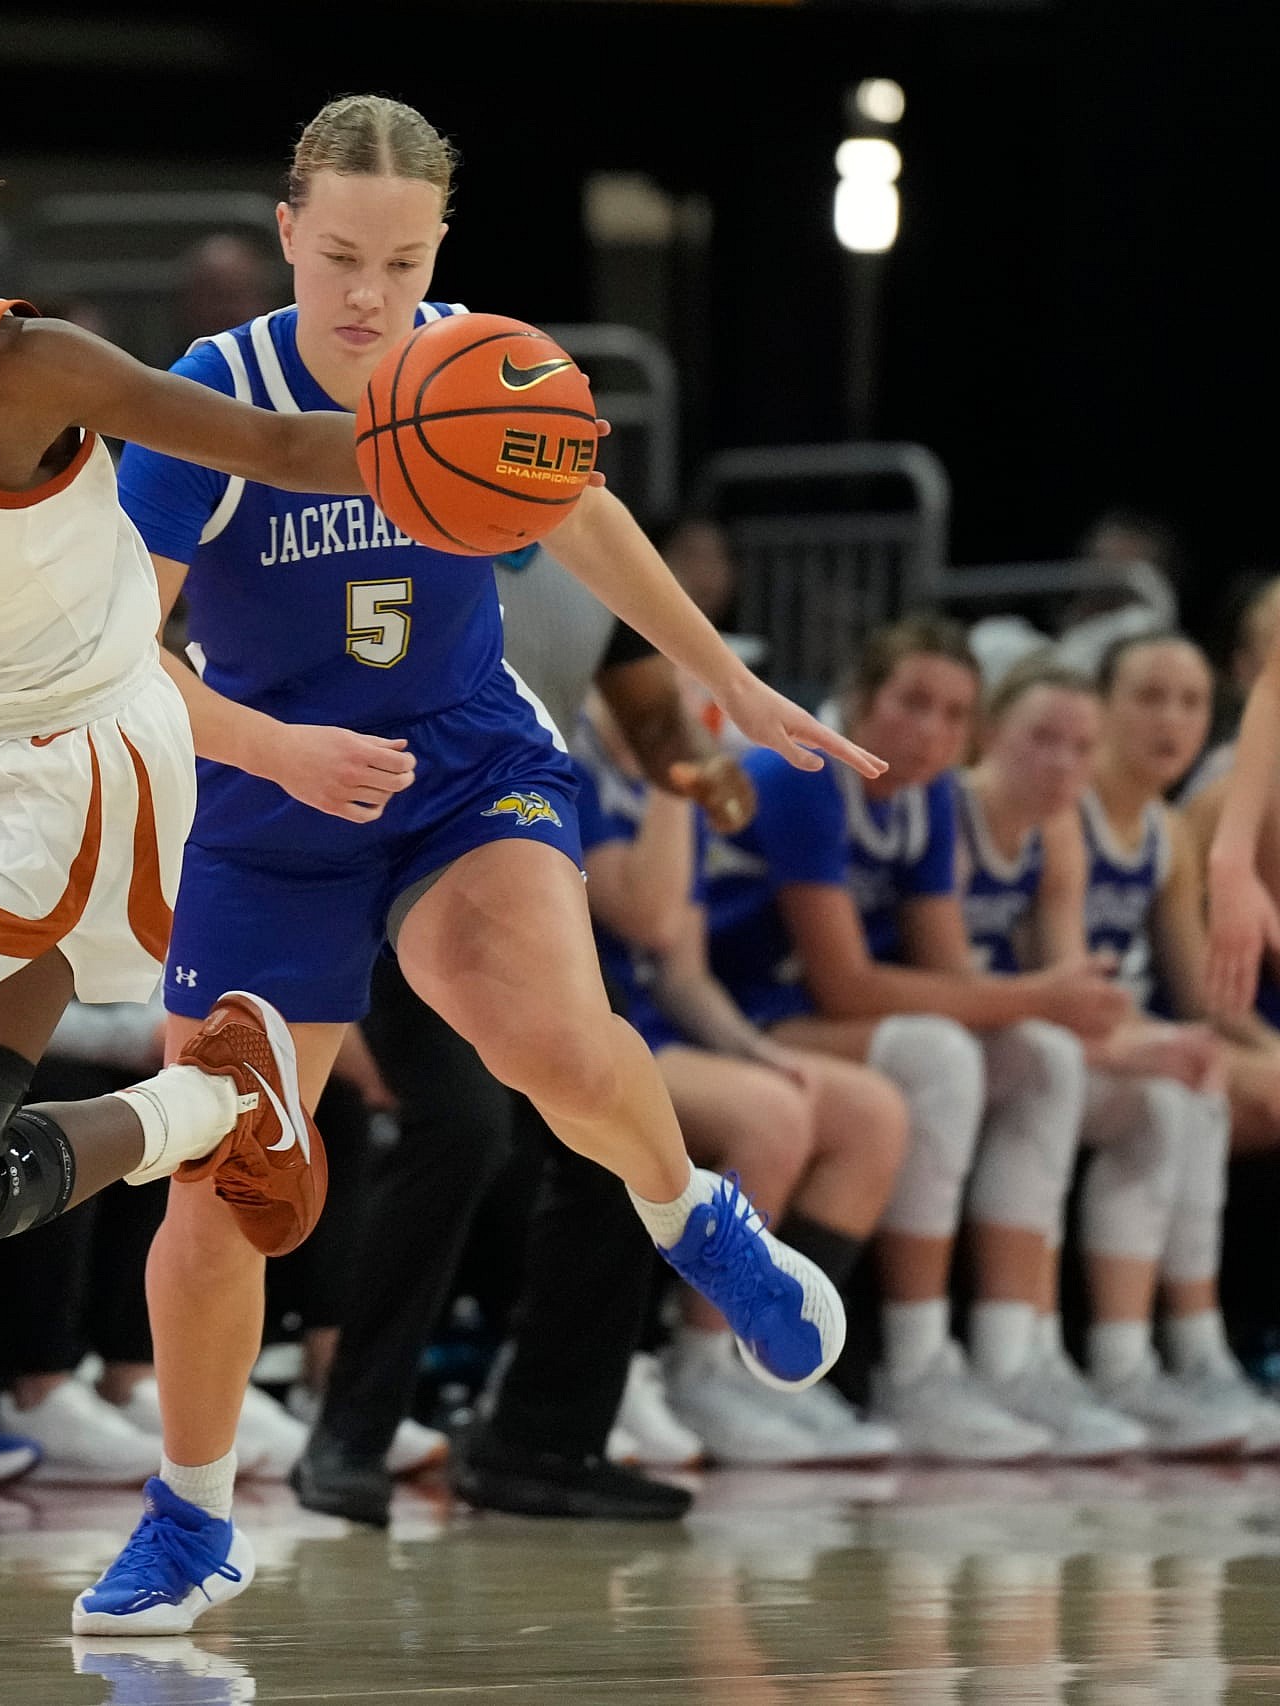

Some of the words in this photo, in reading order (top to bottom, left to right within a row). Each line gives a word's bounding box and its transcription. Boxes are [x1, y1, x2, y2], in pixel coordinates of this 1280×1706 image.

[498, 427, 595, 474] ELITE
[260, 498, 426, 567] JACKRA
[346, 577, 413, 669] 5
